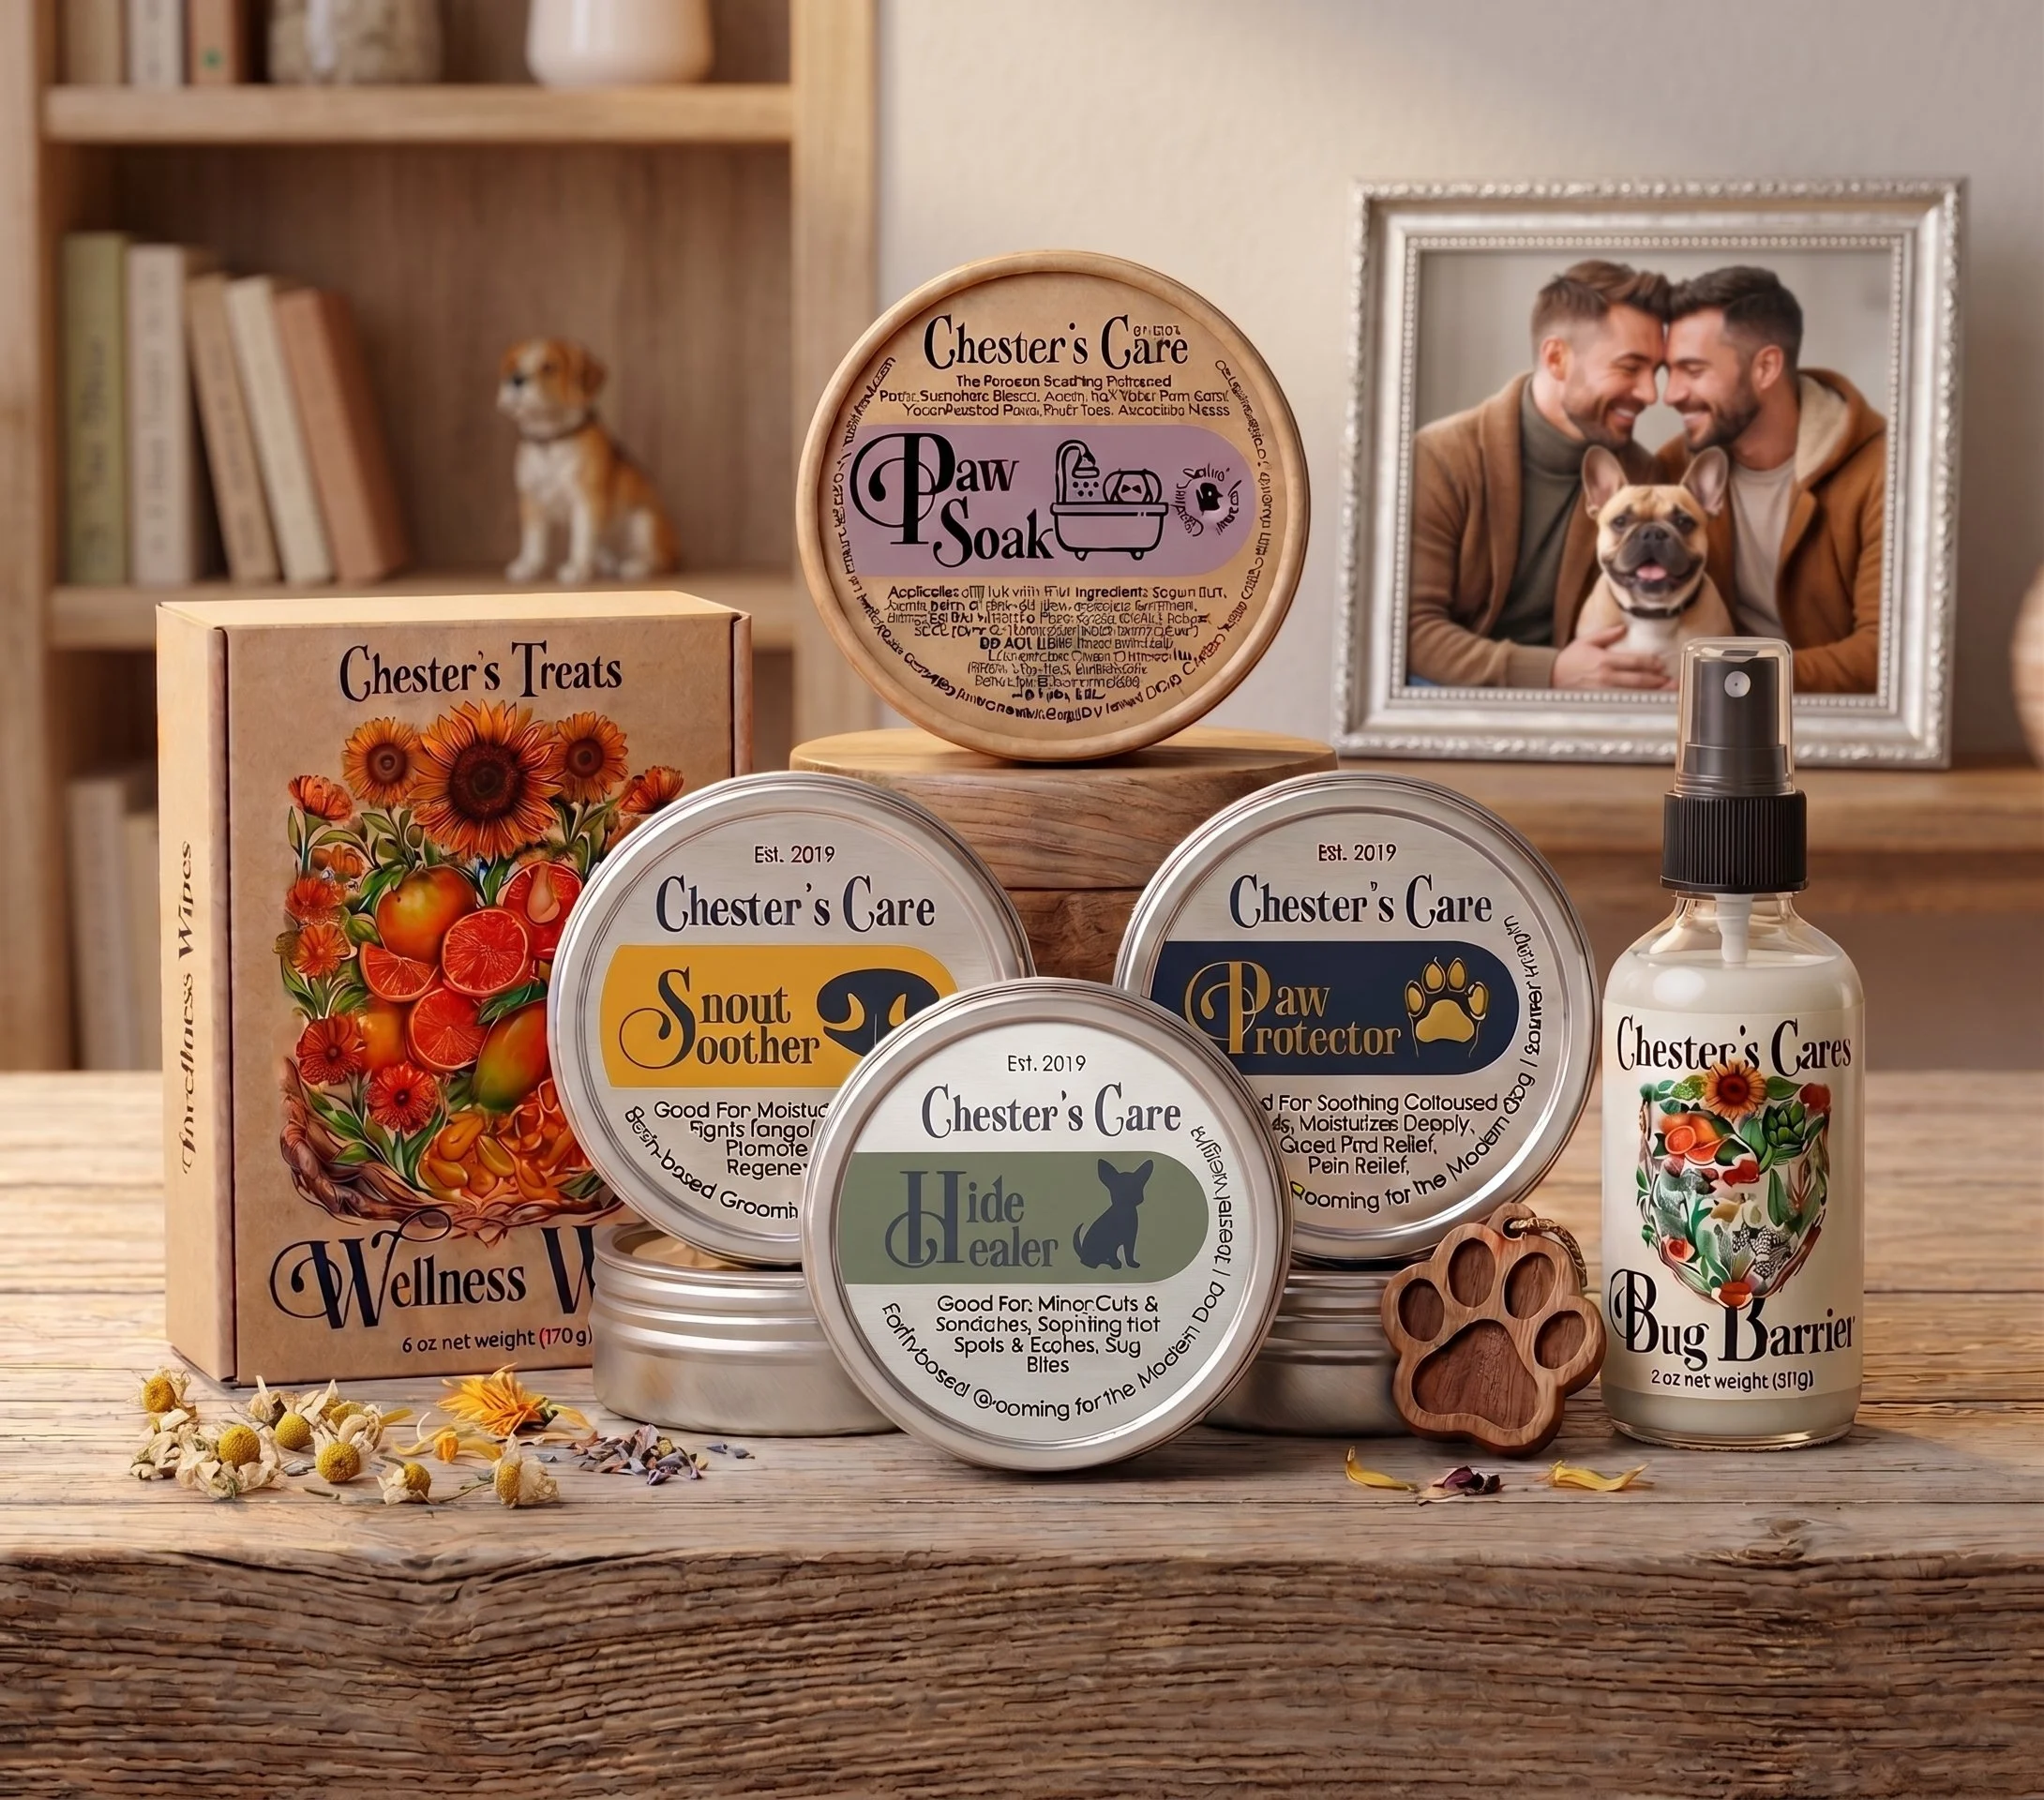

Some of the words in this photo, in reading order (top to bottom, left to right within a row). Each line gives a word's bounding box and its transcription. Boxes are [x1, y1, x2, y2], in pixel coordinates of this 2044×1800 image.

[924, 314, 1089, 369] Chester's
[1101, 314, 1188, 370] Care
[956, 375, 981, 387] The
[849, 432, 1019, 545] Paw
[933, 497, 1055, 568] Soak
[340, 644, 500, 702] Chester's
[512, 640, 623, 698] Treats
[754, 846, 785, 863] Est.
[790, 846, 835, 863] 2019
[1317, 844, 1347, 862] Est.
[1354, 844, 1397, 862] 2019
[656, 875, 831, 932] Chester's
[843, 875, 936, 933] Care
[1229, 873, 1394, 929] Chester's
[1405, 873, 1493, 929] Care
[1183, 960, 1330, 1056] Paw
[1007, 1056, 1037, 1072] Est.
[1043, 1056, 1087, 1072] 2019
[1617, 1014, 1760, 1073] Chester's
[1770, 1018, 1852, 1077] Cares
[654, 1101, 710, 1118] Good
[716, 1102, 751, 1118] For
[922, 1083, 1084, 1138] Chester's
[1094, 1082, 1181, 1137] Care
[1279, 1094, 1313, 1111] For
[1317, 1093, 1399, 1115] Soothing
[269, 1208, 527, 1329] Wellness
[937, 1295, 993, 1312] Good
[1095, 1295, 1139, 1312] Cuts
[1144, 1296, 1159, 1312] &
[1609, 1268, 1710, 1371] Bug
[401, 1337, 413, 1354] 6
[416, 1339, 438, 1352] oz
[443, 1334, 472, 1351] net
[474, 1328, 536, 1351] weight
[1011, 1337, 1024, 1353] &
[1105, 1336, 1141, 1358] Sug
[1651, 1369, 1661, 1384] 2
[1662, 1372, 1681, 1387] oz
[1685, 1372, 1712, 1388] net
[1714, 1372, 1769, 1393] weight
